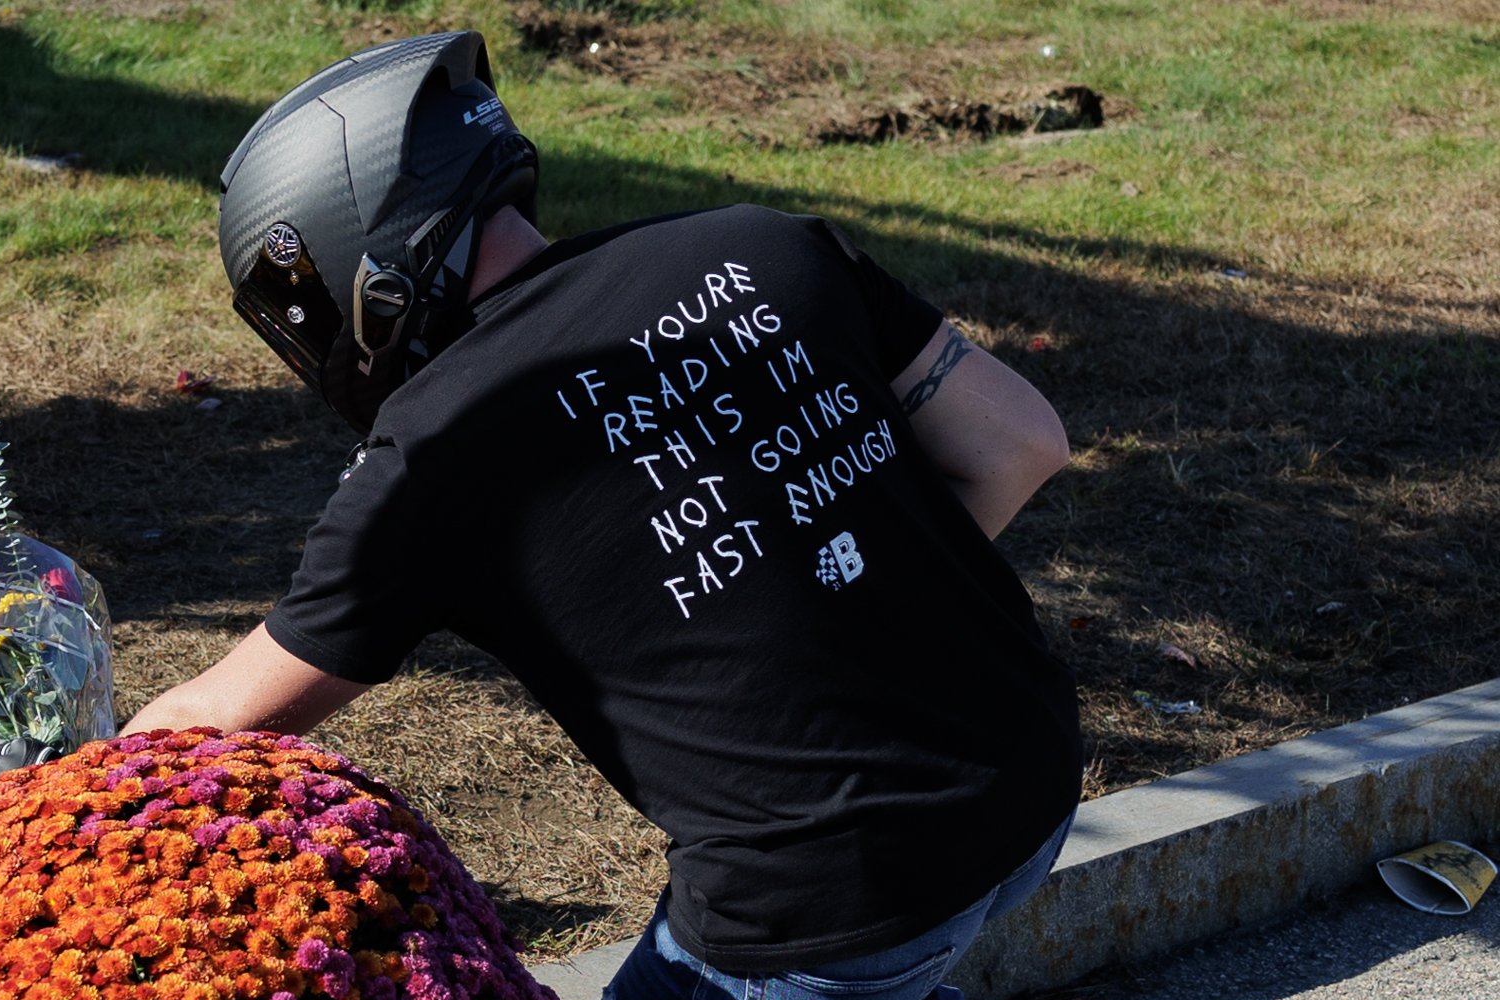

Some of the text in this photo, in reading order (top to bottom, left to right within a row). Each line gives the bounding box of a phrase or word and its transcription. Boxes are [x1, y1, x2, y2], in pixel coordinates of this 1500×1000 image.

[463, 97, 502, 125] LS2
[557, 262, 756, 419] IF YOURE
[603, 303, 782, 453] READING
[633, 340, 815, 491] THIS IM
[650, 382, 859, 554] NOT GOING
[663, 419, 896, 619] FAST ENOUGH
[829, 531, 865, 584] B
